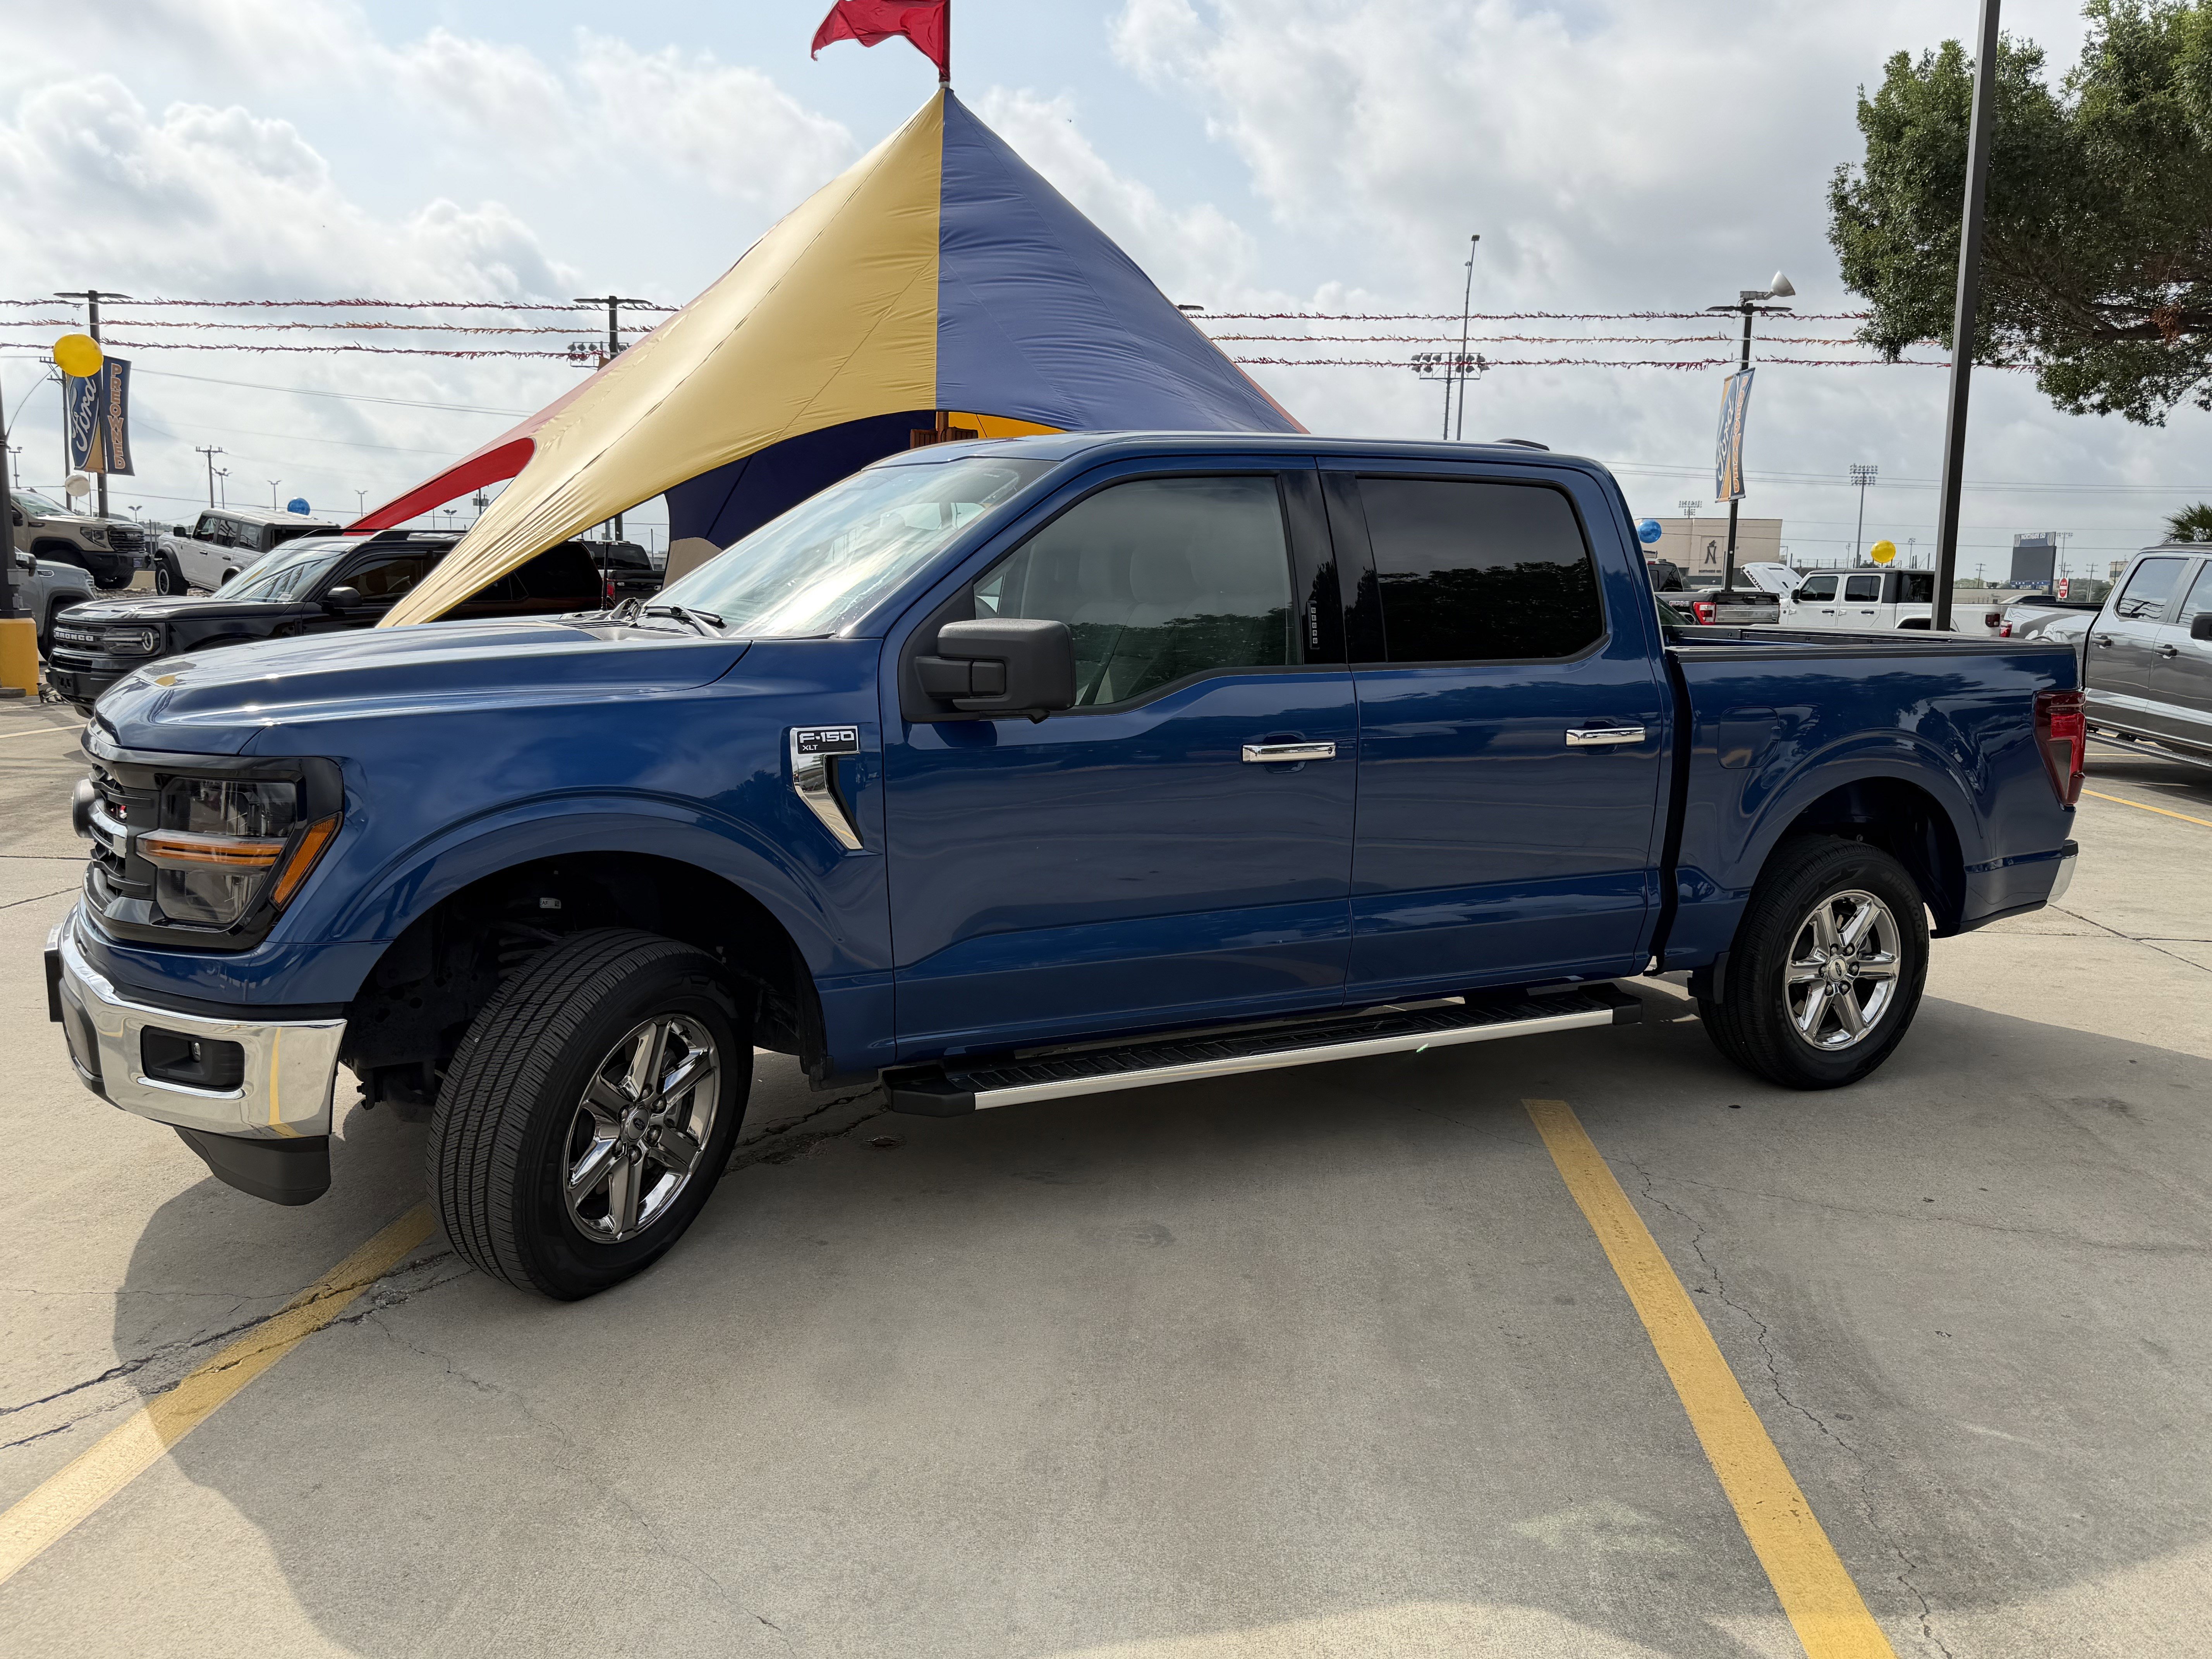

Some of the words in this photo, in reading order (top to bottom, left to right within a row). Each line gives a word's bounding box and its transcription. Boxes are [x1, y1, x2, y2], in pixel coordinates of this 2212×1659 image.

[70, 377, 97, 452] Ford
[107, 363, 125, 469] PREOWNED
[1716, 397, 1734, 481] Ford
[1733, 376, 1748, 493] PREOWNED
[799, 731, 855, 743] F-150
